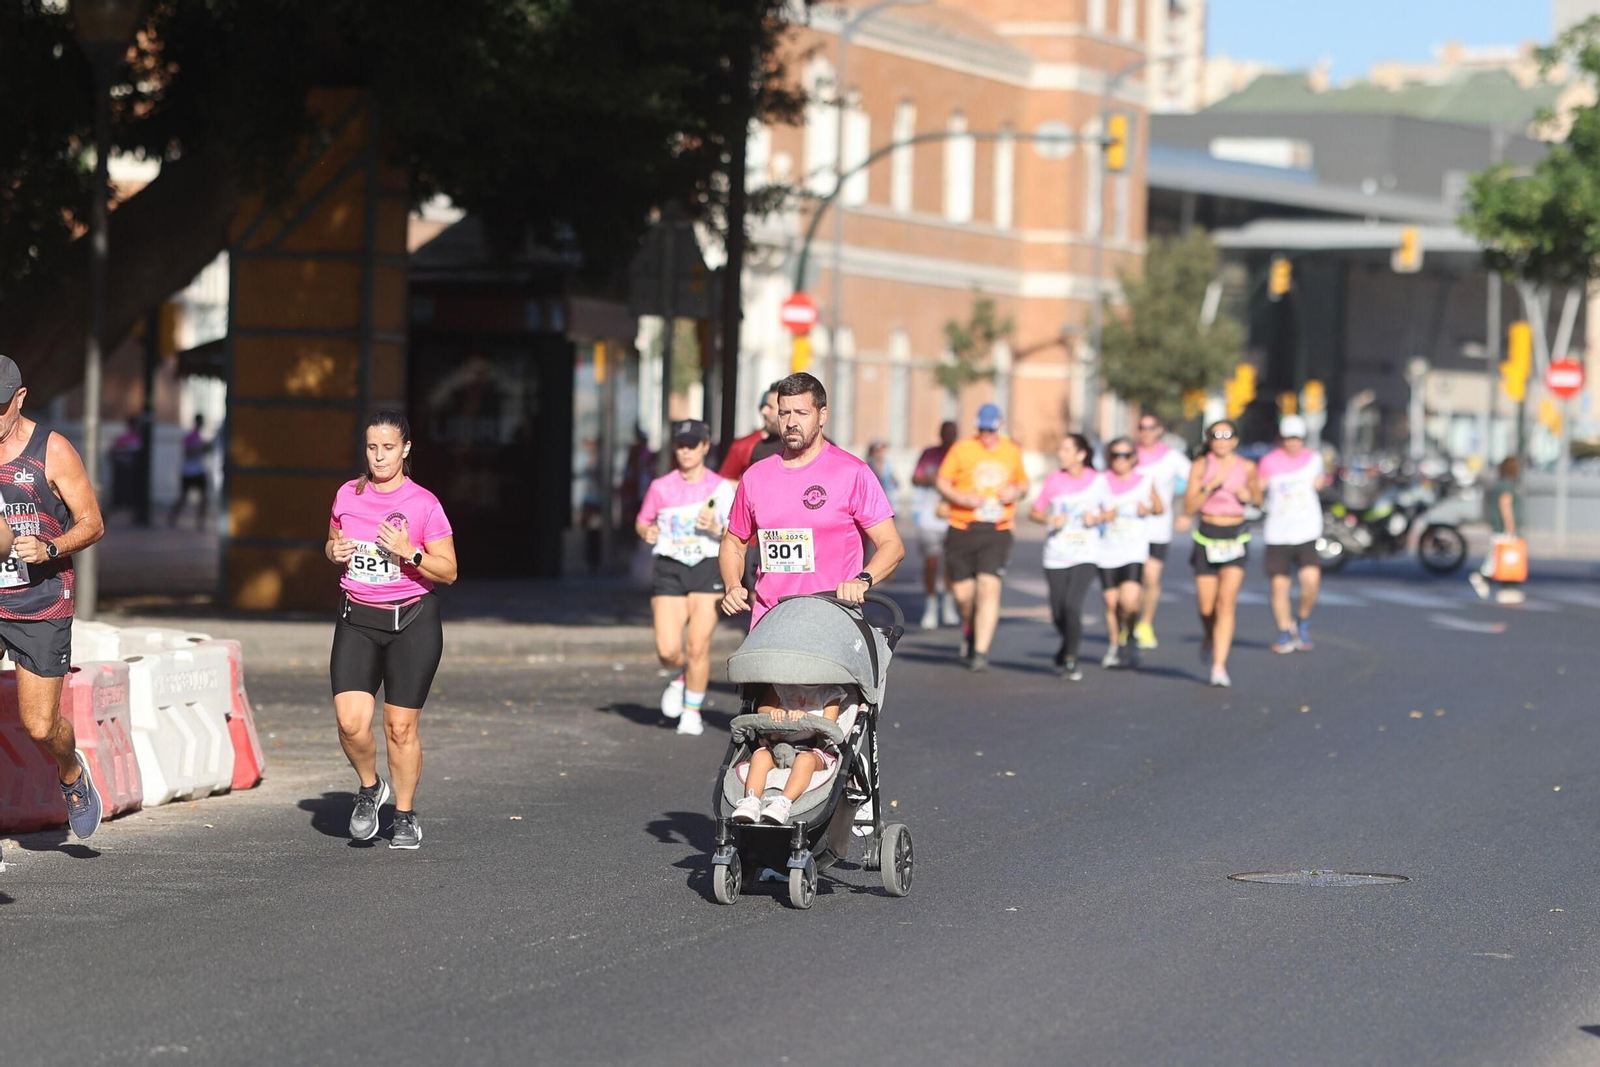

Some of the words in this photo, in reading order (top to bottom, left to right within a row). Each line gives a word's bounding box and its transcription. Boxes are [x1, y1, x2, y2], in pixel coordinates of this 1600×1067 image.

[768, 544, 802, 559] 301
[0, 557, 18, 573] 8
[354, 555, 388, 573] 521
